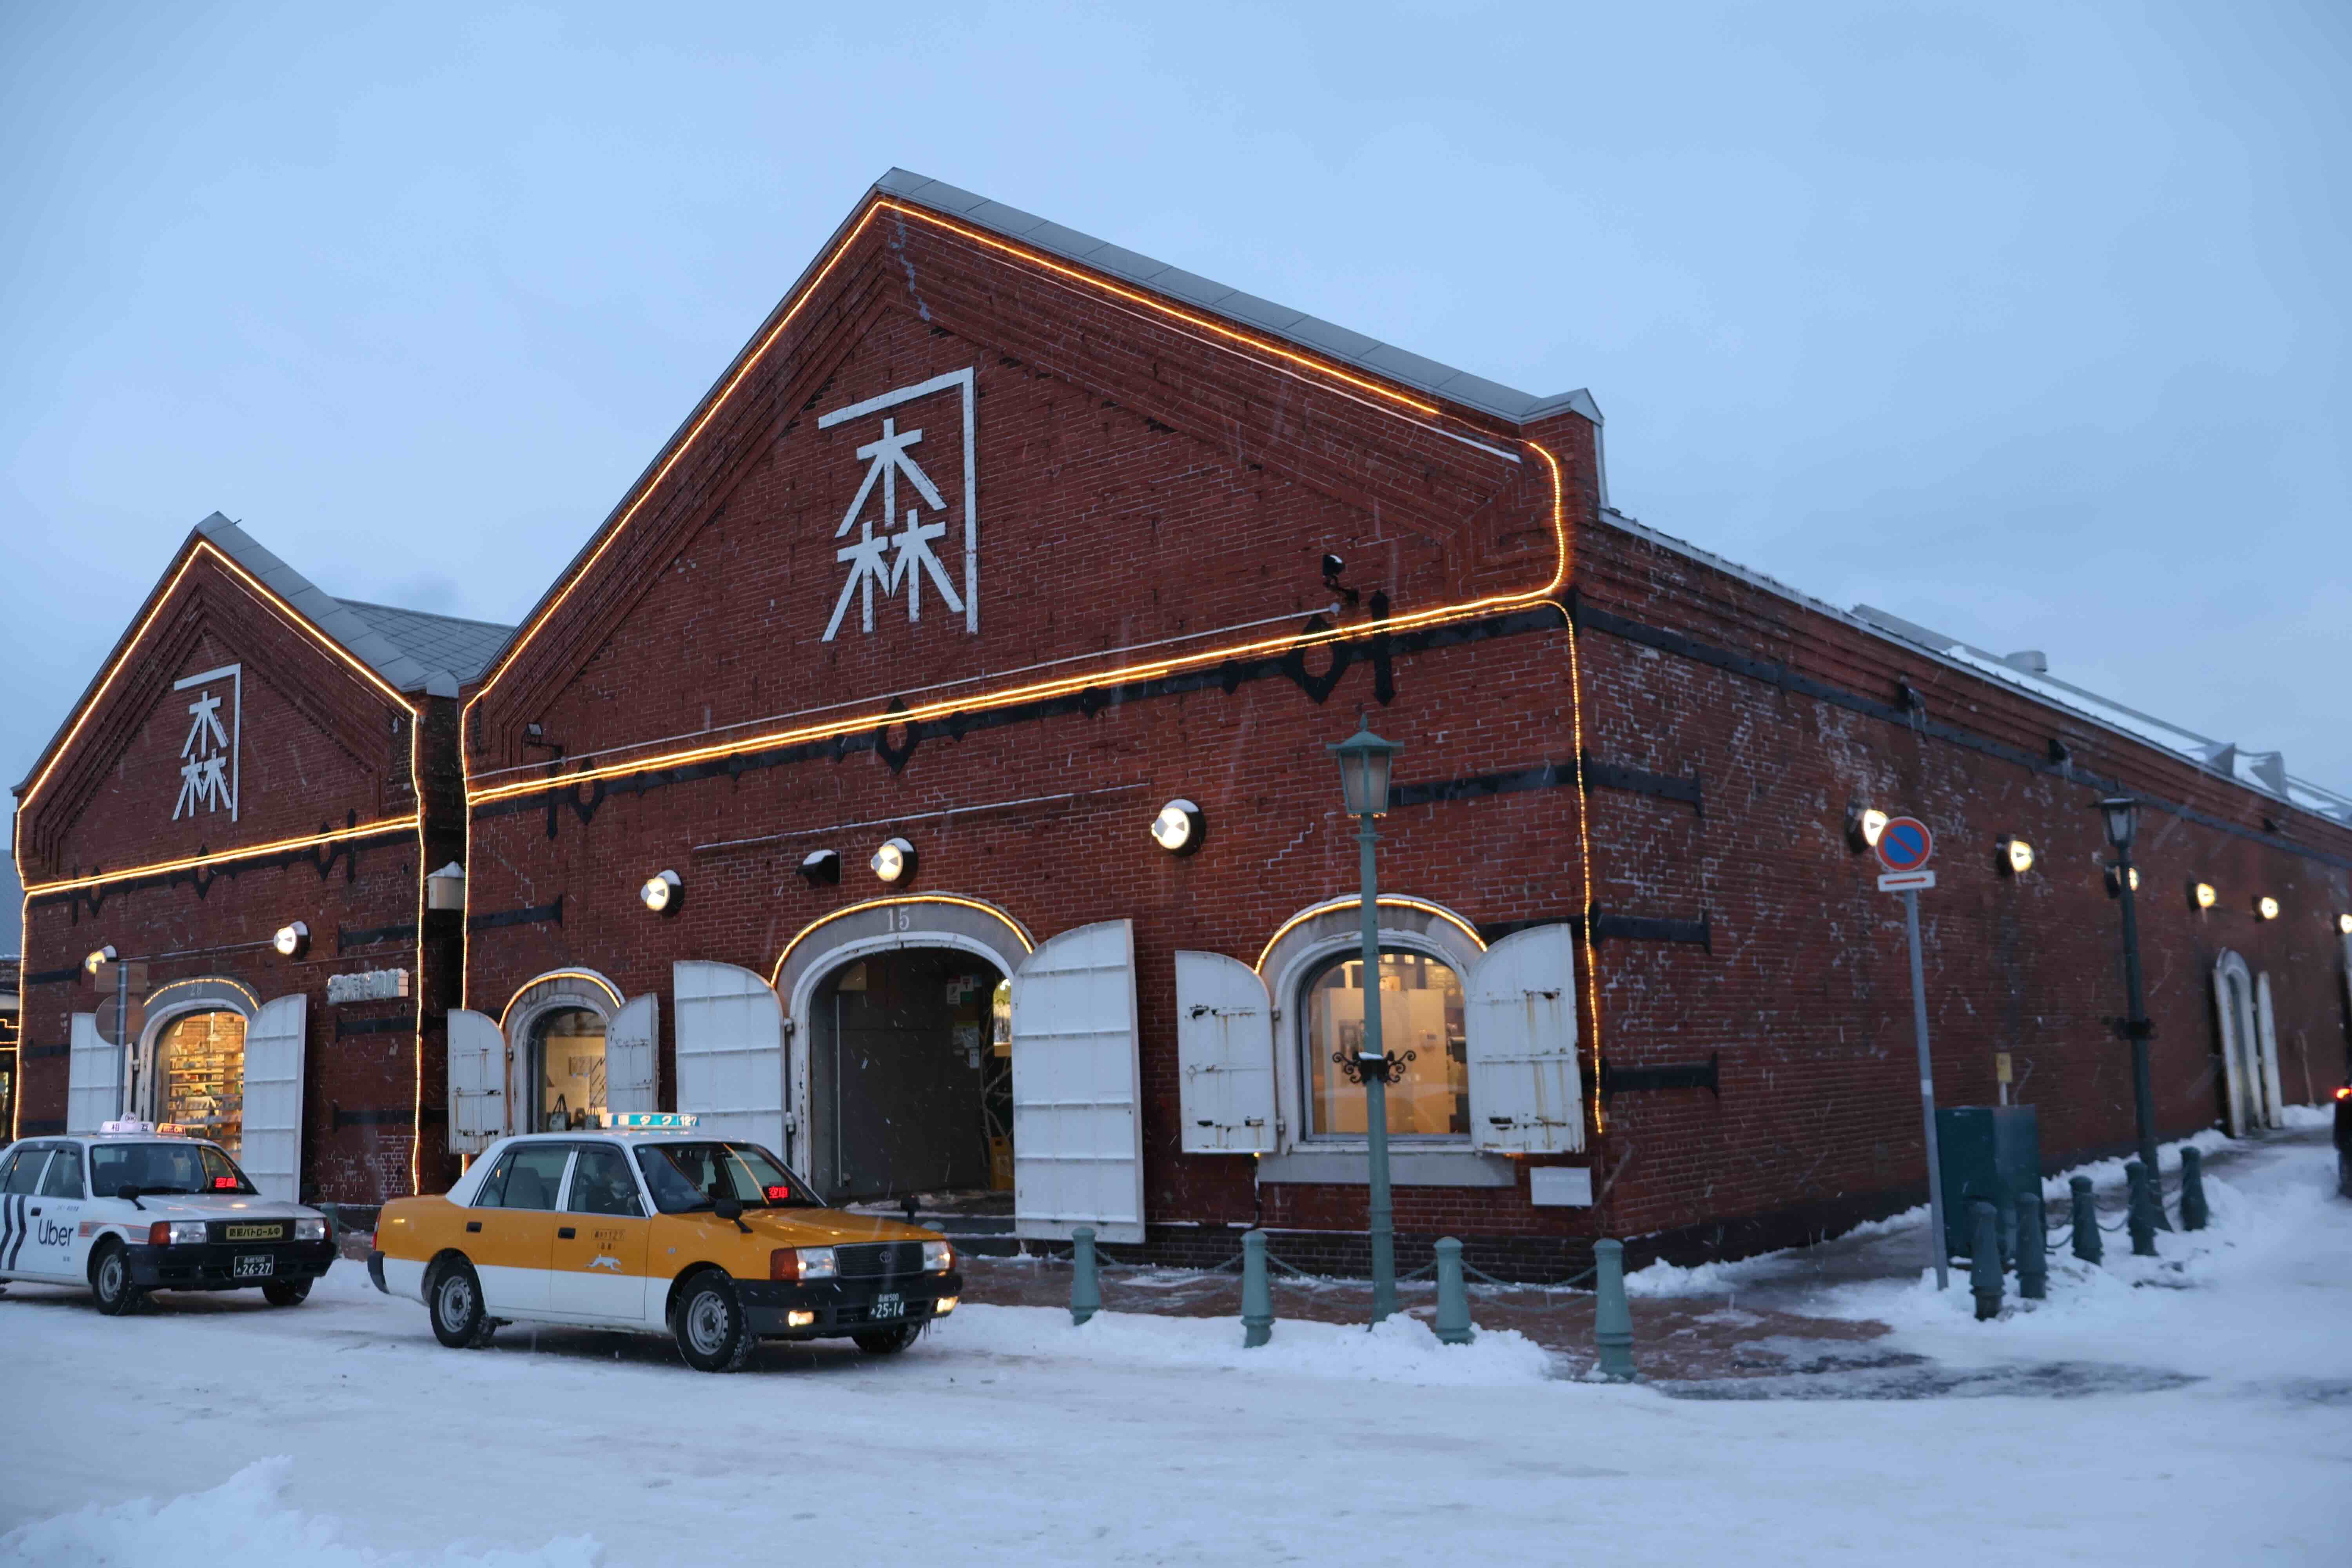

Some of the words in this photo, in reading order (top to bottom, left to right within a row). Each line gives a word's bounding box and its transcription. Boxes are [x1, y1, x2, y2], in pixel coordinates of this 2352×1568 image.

[887, 906, 909, 931] 15
[680, 1116, 697, 1126] 127
[769, 1186, 788, 1198] 空車
[38, 1219, 74, 1246] Uber
[229, 1227, 280, 1237] 防犯パトロール中
[242, 1263, 270, 1275] 26-27
[876, 1301, 904, 1318] 25-14
